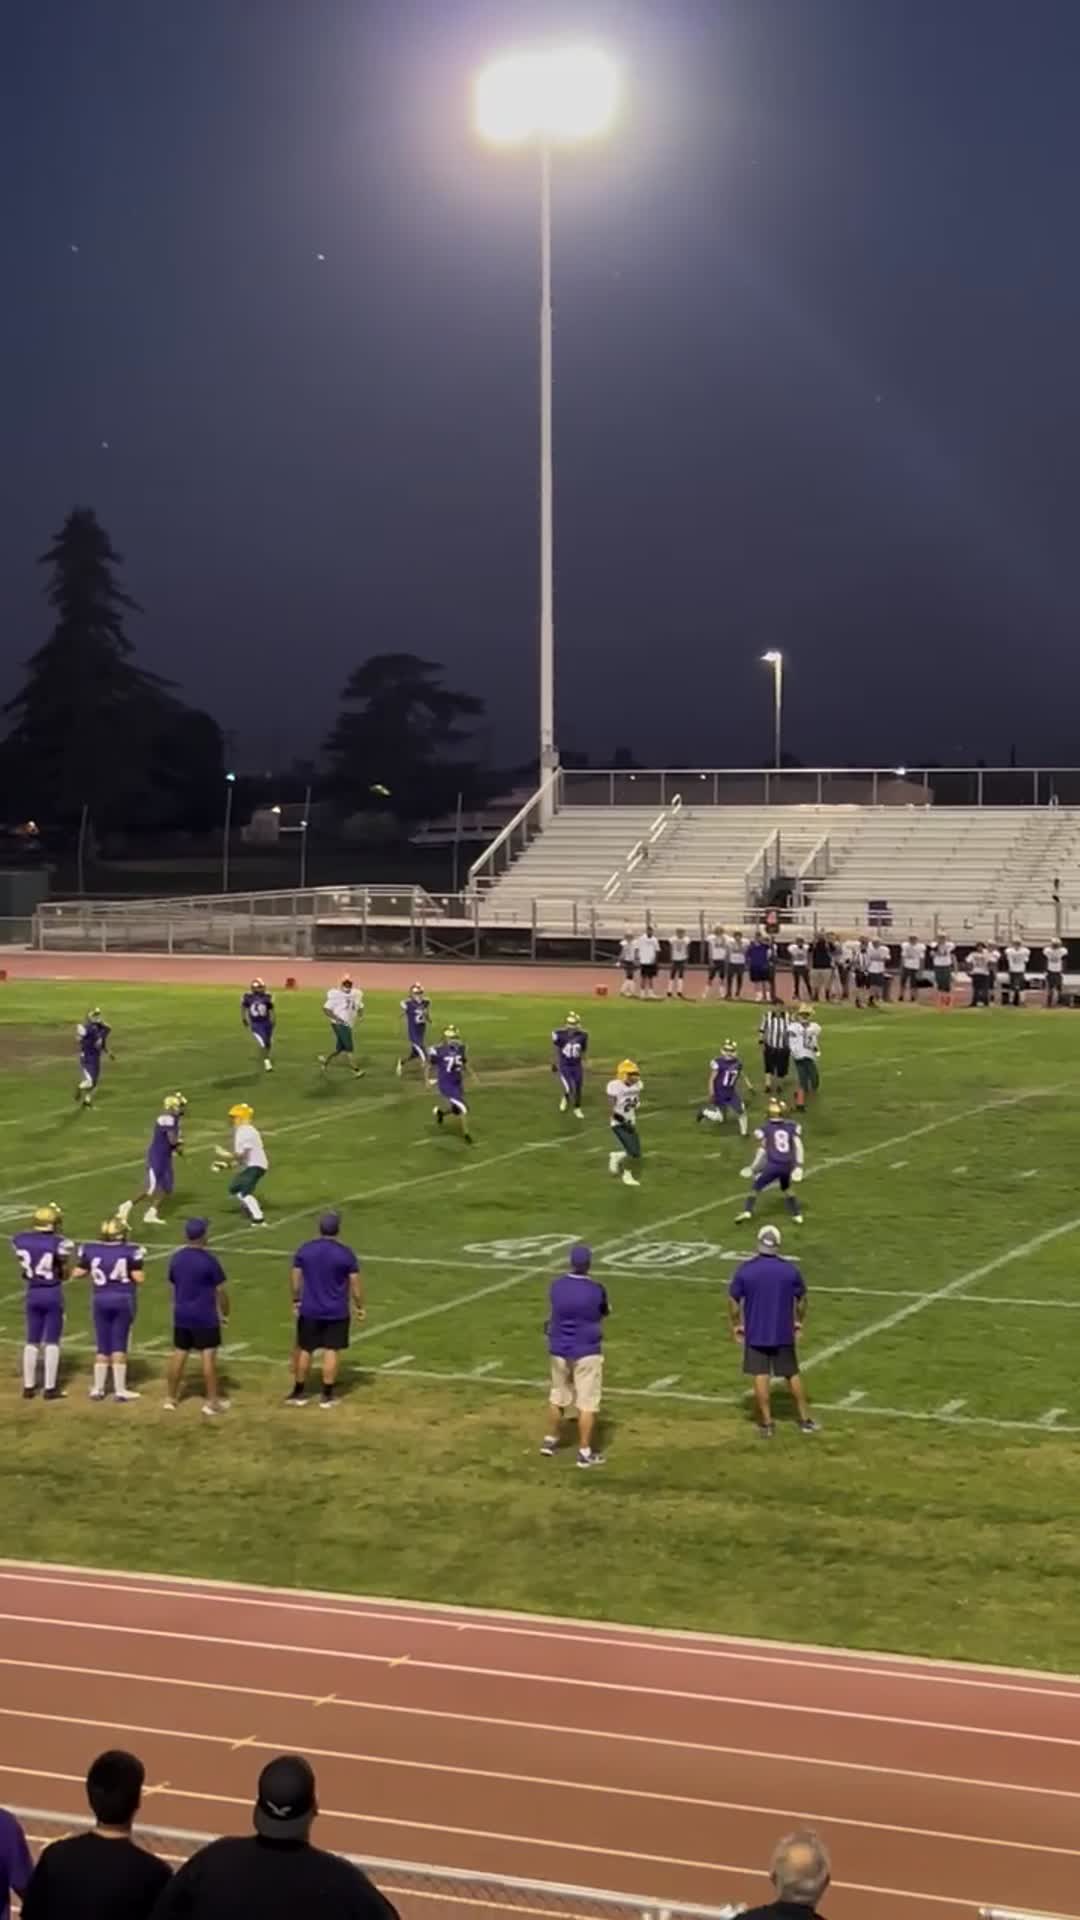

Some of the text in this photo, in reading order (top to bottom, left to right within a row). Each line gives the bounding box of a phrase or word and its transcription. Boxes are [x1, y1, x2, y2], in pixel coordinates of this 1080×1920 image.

[443, 1056, 463, 1073] 75
[723, 1070, 738, 1087] 17
[774, 1129, 790, 1153] 8
[16, 1248, 54, 1280] 34
[91, 1257, 130, 1286] 64
